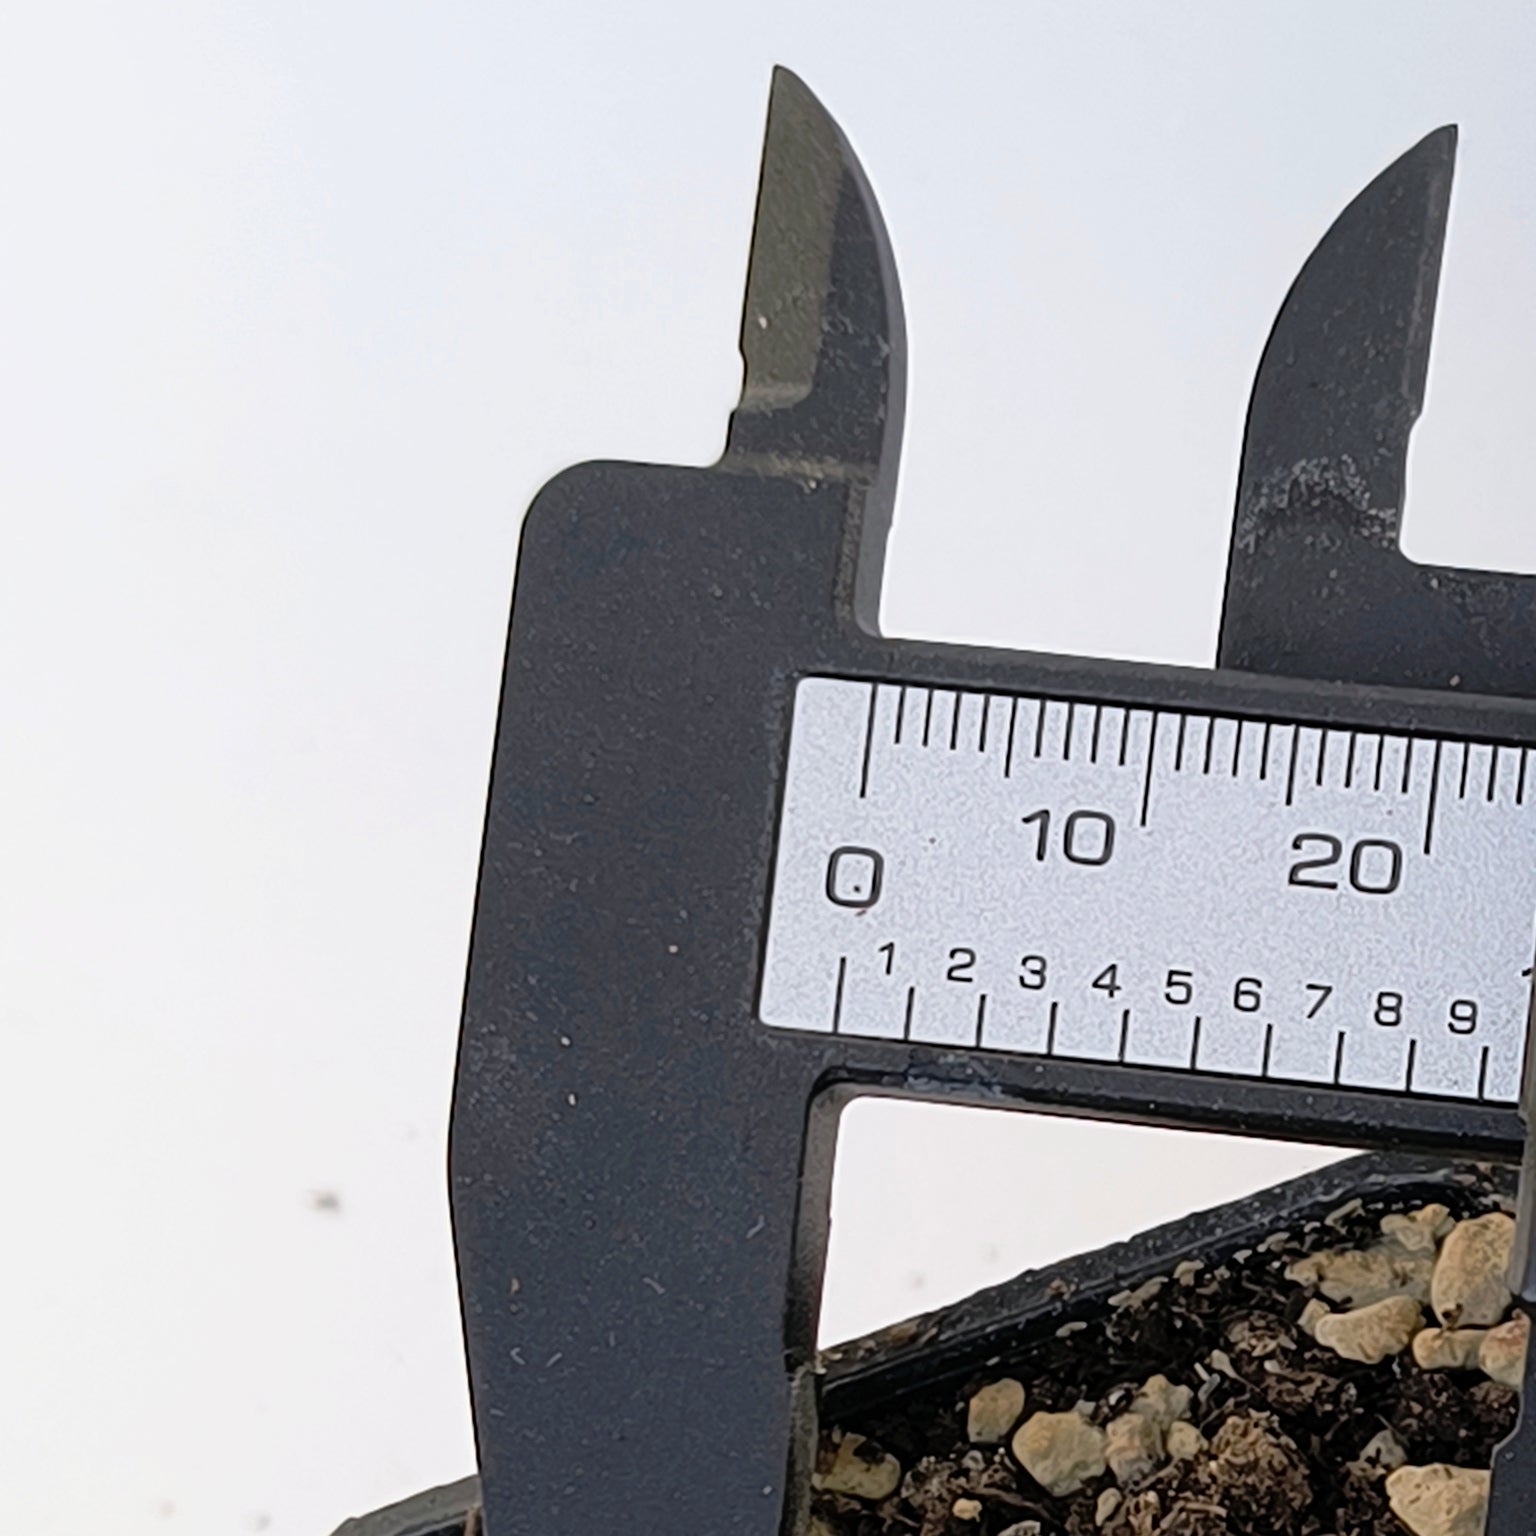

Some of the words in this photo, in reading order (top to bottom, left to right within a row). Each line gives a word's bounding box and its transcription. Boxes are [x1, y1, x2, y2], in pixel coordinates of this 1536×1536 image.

[824, 845, 884, 909] 0
[1020, 808, 1115, 867] 10
[1288, 833, 1403, 895] 20
[877, 941, 896, 976] 1
[946, 947, 976, 984] 2
[1018, 954, 1048, 991] 3
[1091, 962, 1123, 999] 4
[1164, 969, 1194, 1006] 5
[1233, 976, 1263, 1014] 6
[1304, 983, 1334, 1021] 7
[1373, 991, 1403, 1028] 8
[1447, 998, 1479, 1036] 9
